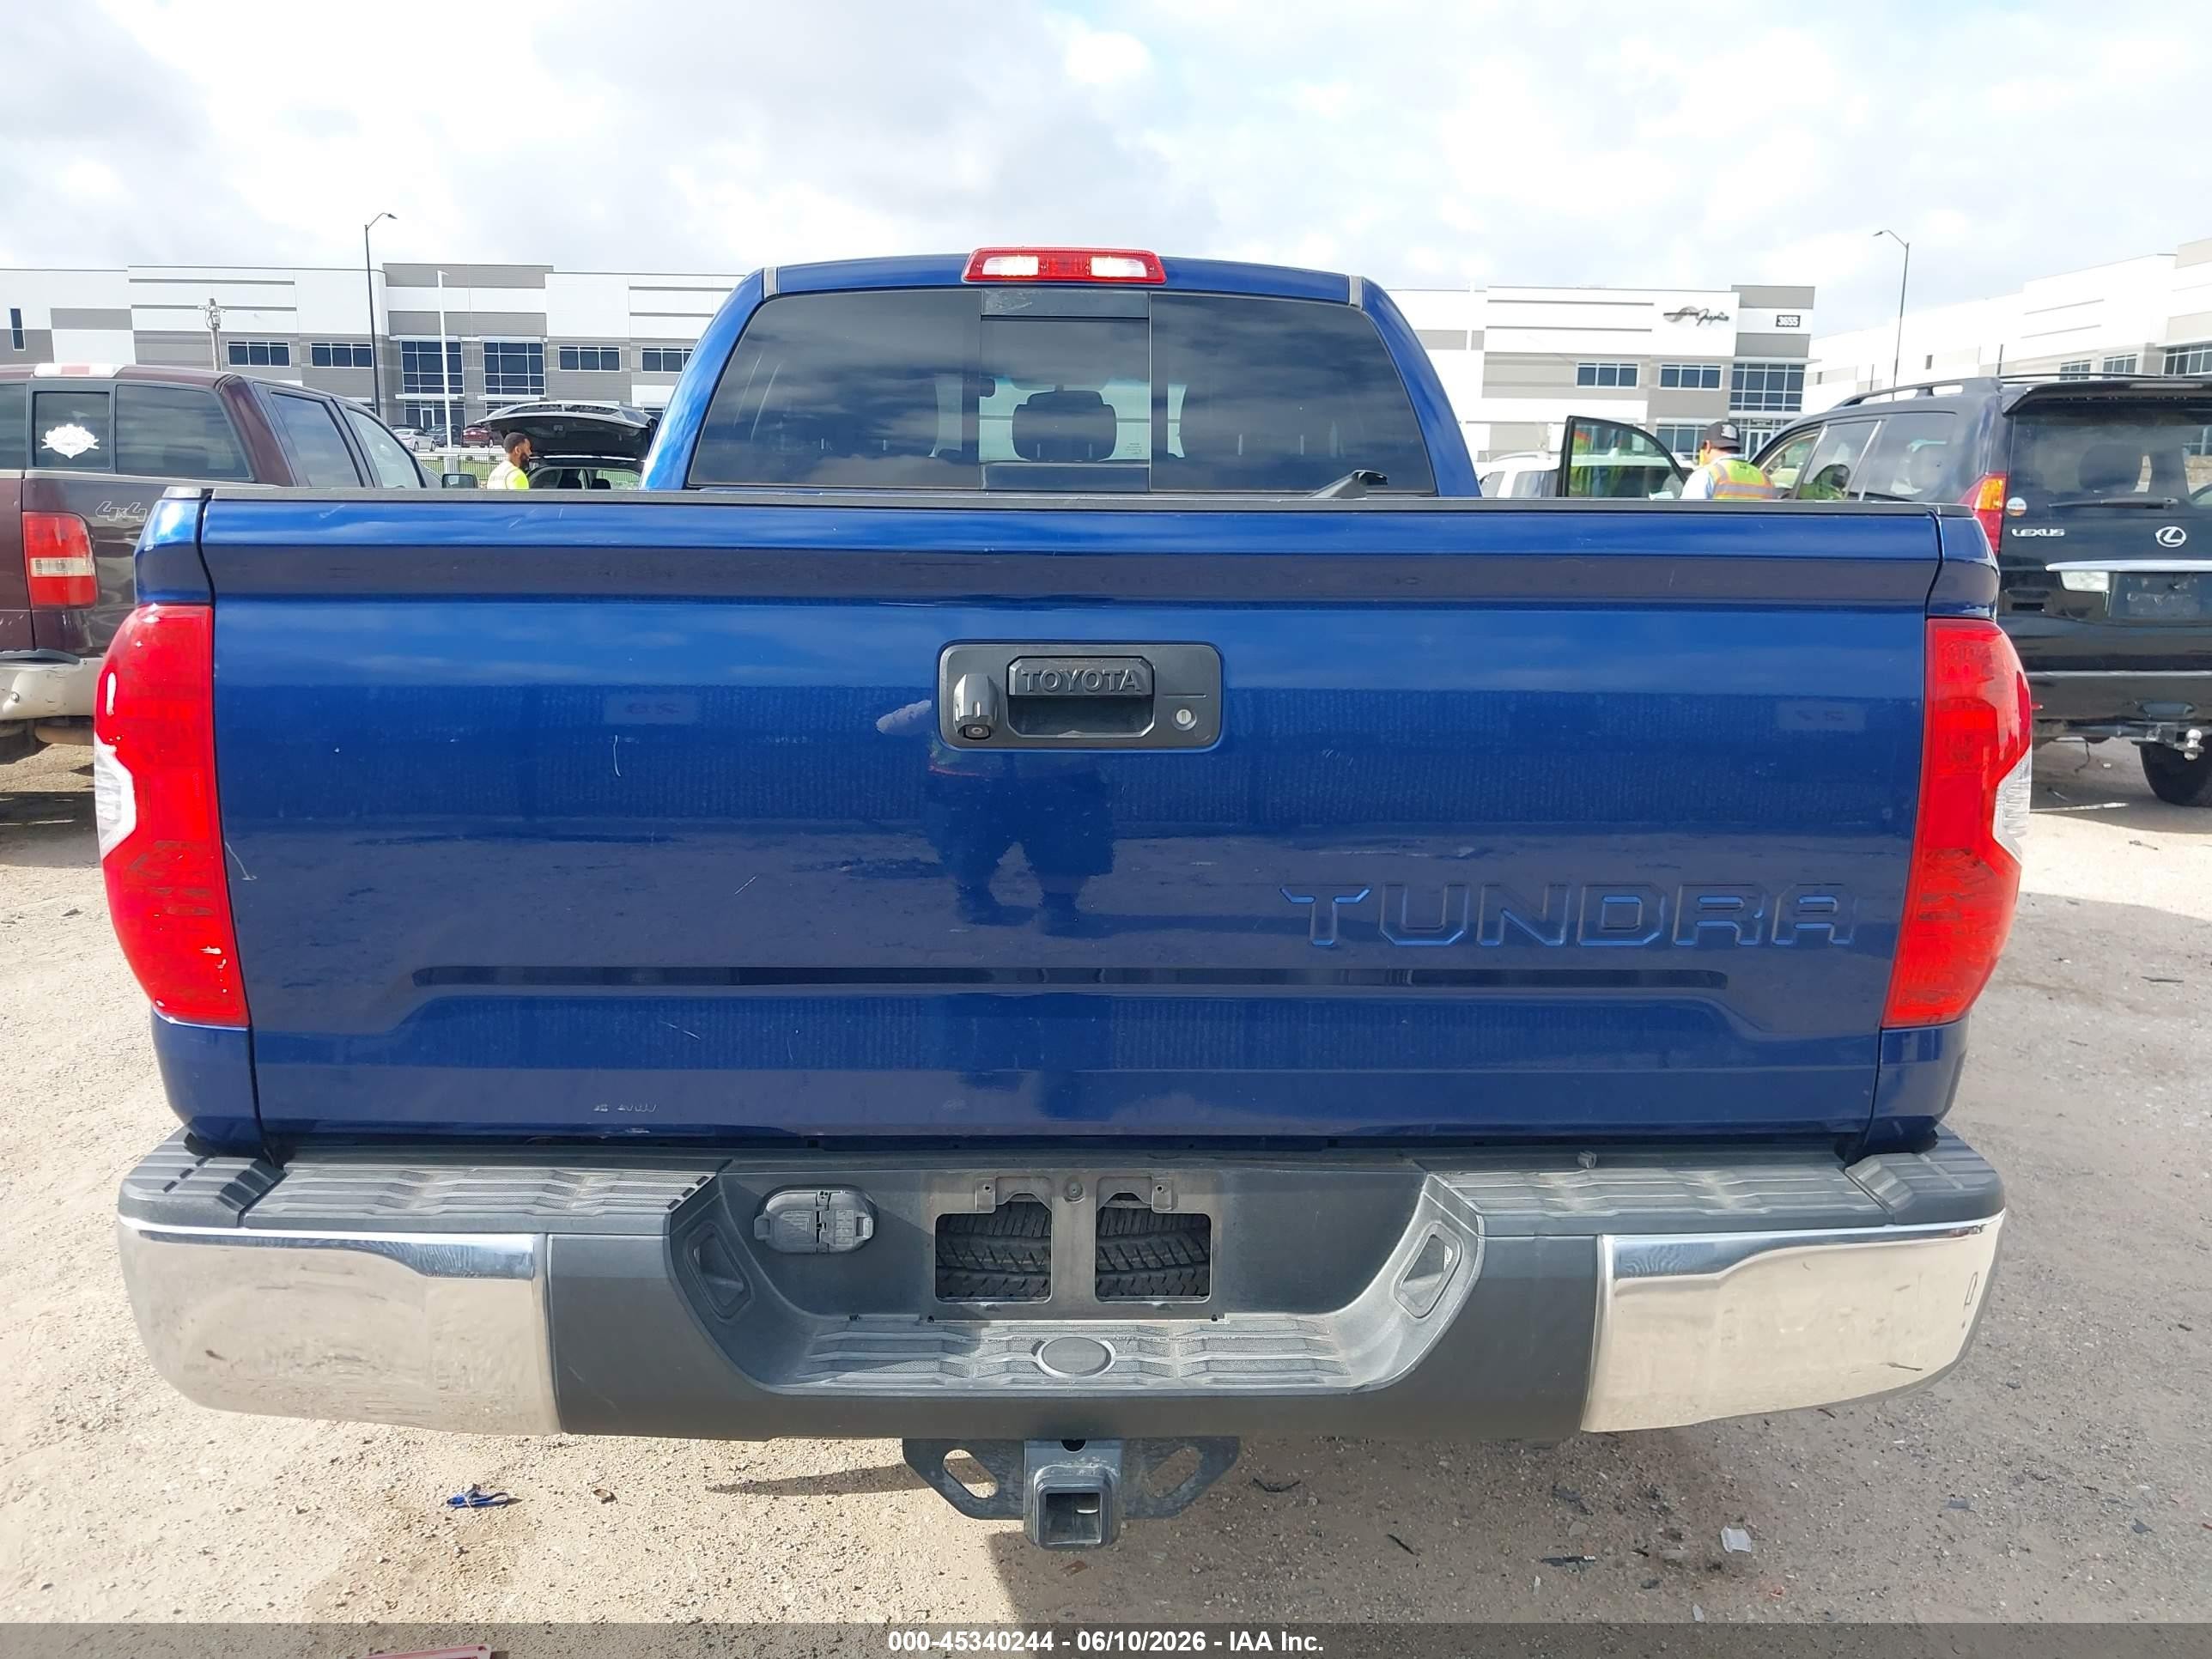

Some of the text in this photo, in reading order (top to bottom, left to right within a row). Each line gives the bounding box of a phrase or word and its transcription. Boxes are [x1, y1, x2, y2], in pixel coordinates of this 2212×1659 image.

[95, 501, 148, 522] 4x4
[2011, 528, 2065, 538] LEXUS
[1021, 667, 1142, 694] TOYOTA
[1279, 883, 1859, 945] TUNDRA
